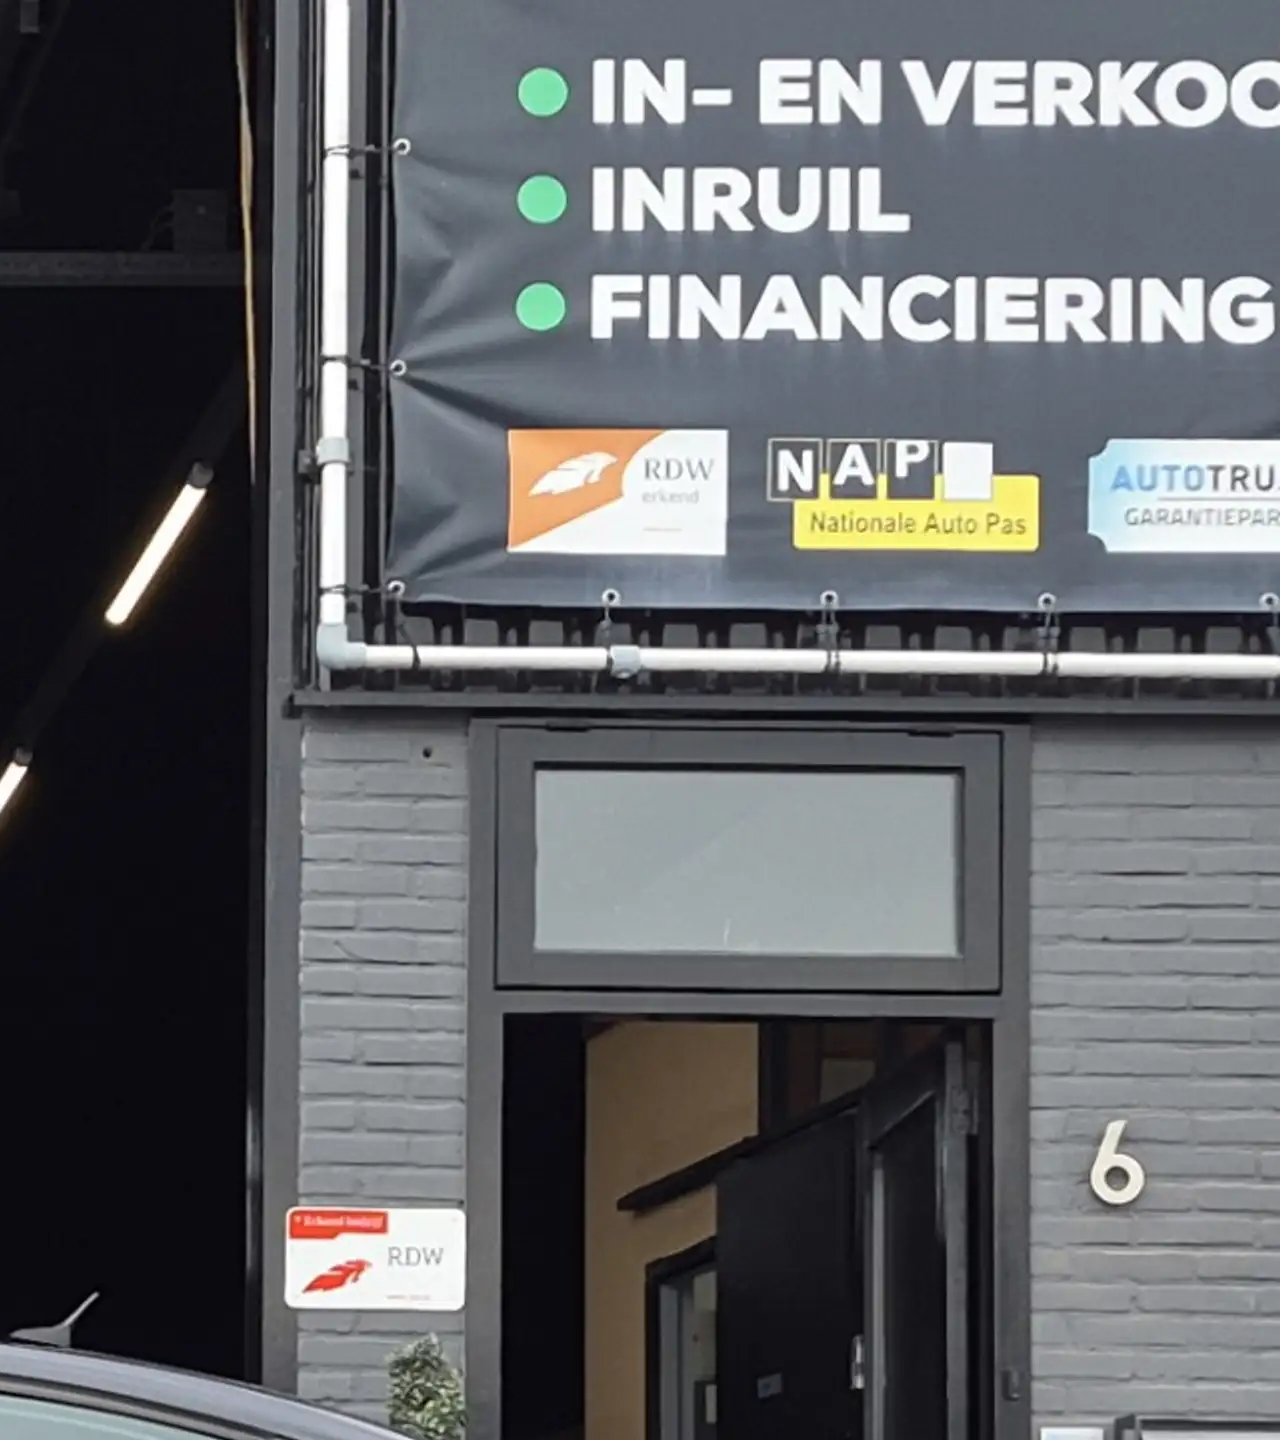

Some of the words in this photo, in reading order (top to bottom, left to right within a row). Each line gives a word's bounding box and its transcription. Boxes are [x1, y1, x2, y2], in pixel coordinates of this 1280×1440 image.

[592, 58, 733, 125] IN-
[759, 58, 882, 126] EN
[900, 59, 1280, 129] VERKOO
[592, 166, 911, 233] INRUIL
[590, 273, 1276, 345] FINANCIERING
[643, 457, 715, 482] RDW
[776, 438, 930, 493] NAP
[1110, 464, 1280, 492] AUTOTRU
[809, 511, 917, 535] Nationale
[923, 512, 978, 535] Auto
[986, 512, 1027, 536] Pas
[1090, 1119, 1146, 1205] 6
[387, 1246, 445, 1267] RDW
